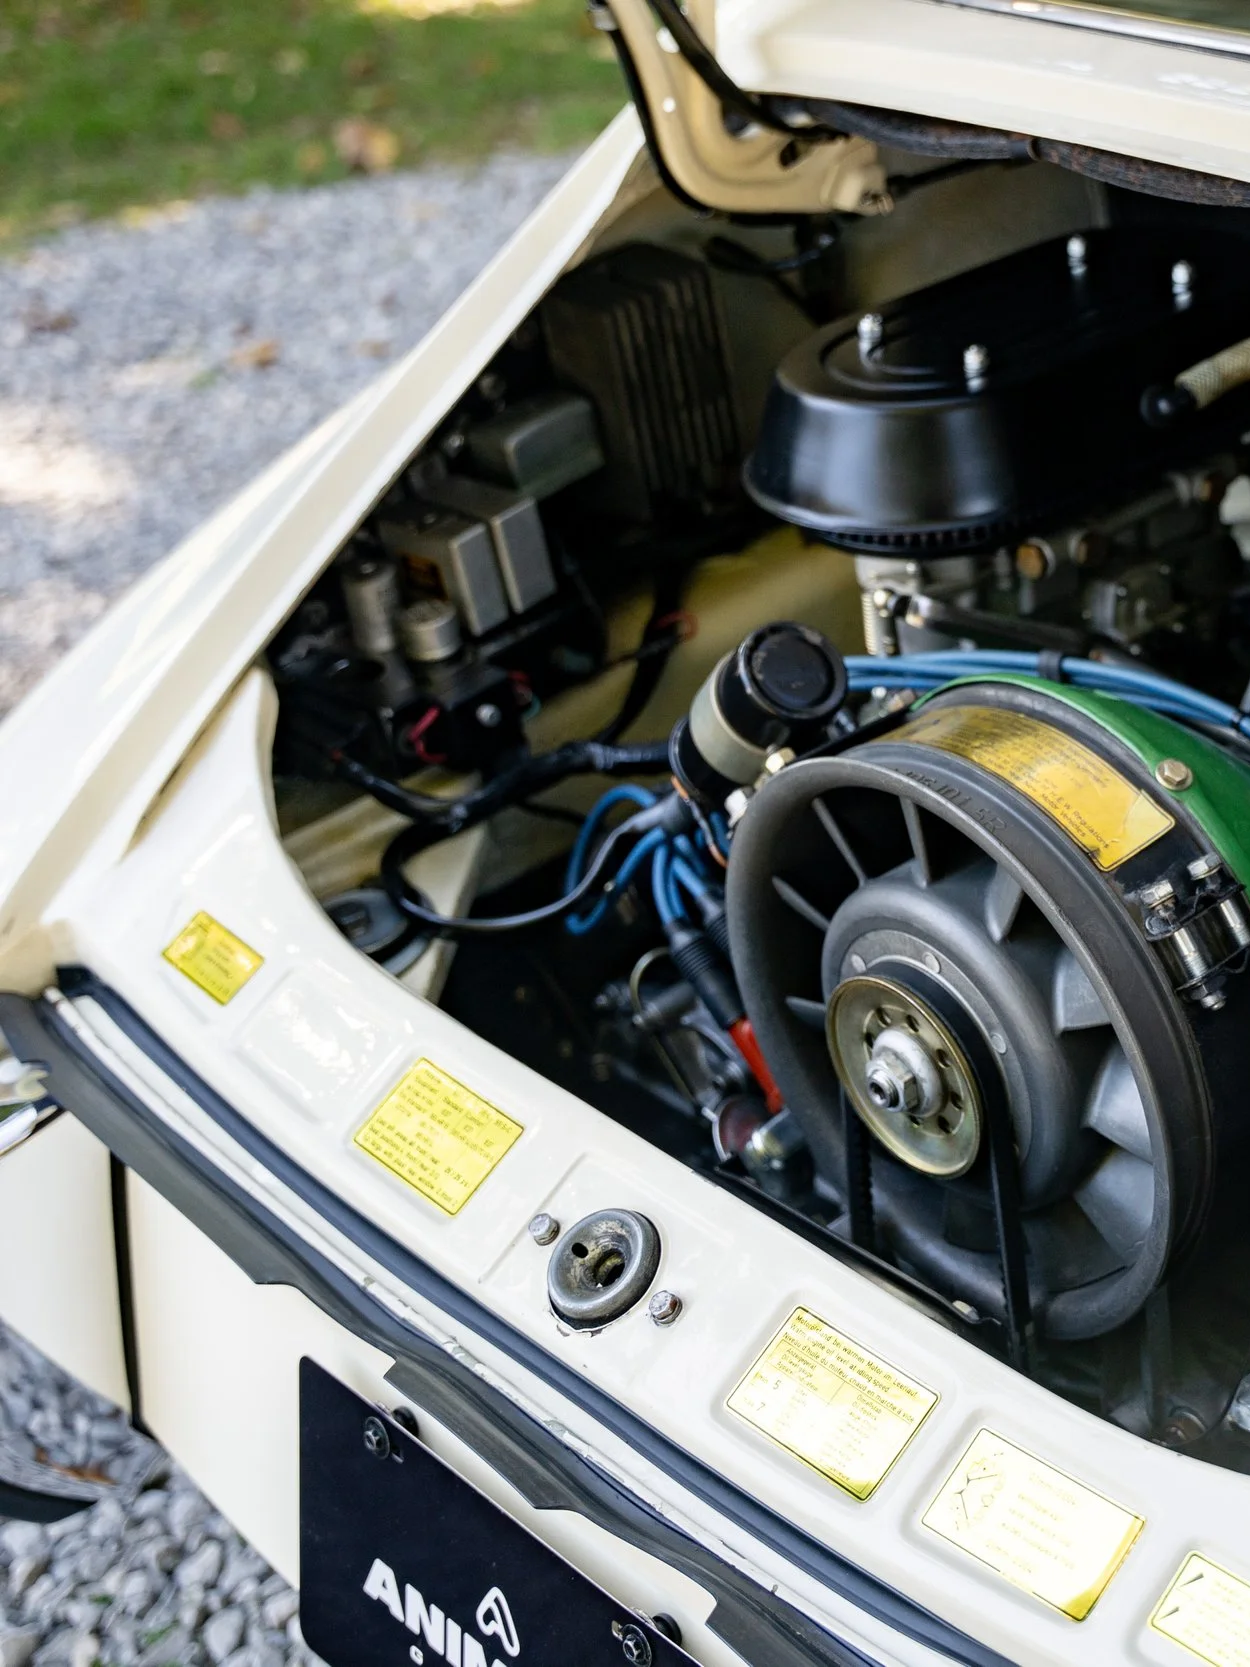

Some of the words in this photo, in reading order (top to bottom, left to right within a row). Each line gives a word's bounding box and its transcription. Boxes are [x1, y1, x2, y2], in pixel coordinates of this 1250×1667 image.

[1042, 793, 1059, 810] Motor
[1060, 811, 1086, 837] Vehicles
[1073, 810, 1109, 848] Regulations
[782, 1332, 802, 1347] Niveau
[820, 1357, 829, 1365] du
[772, 1379, 782, 1390] 5
[834, 1354, 849, 1365] level
[856, 1369, 873, 1382] idling
[872, 1379, 889, 1393] speed
[865, 1361, 883, 1375] Motor
